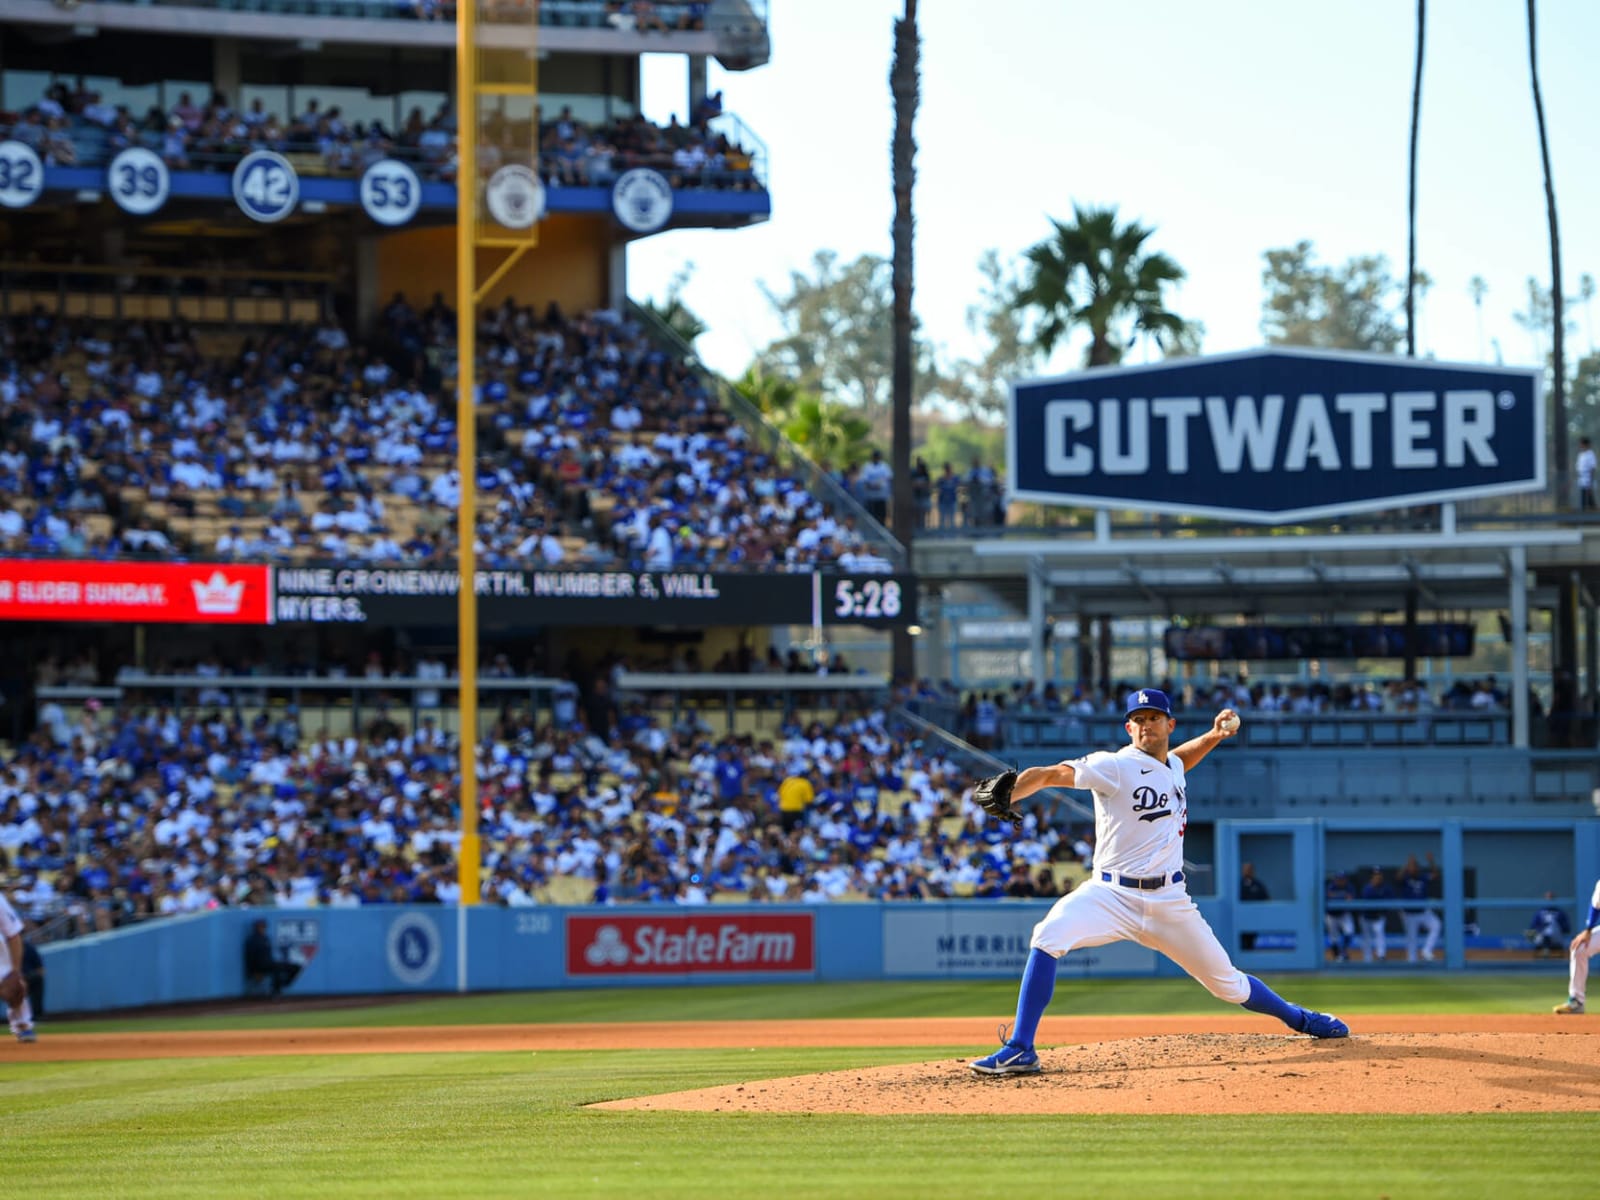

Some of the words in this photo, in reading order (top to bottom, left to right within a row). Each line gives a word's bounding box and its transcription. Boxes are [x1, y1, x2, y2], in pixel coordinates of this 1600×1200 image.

[118, 164, 160, 197] 39
[242, 165, 290, 206] 42
[370, 176, 411, 208] 53
[534, 572, 634, 597] NUMBER
[662, 573, 720, 598] WILL
[835, 580, 901, 618] 5:28
[1138, 690, 1149, 704] LA
[937, 935, 1027, 954] MERRIL
